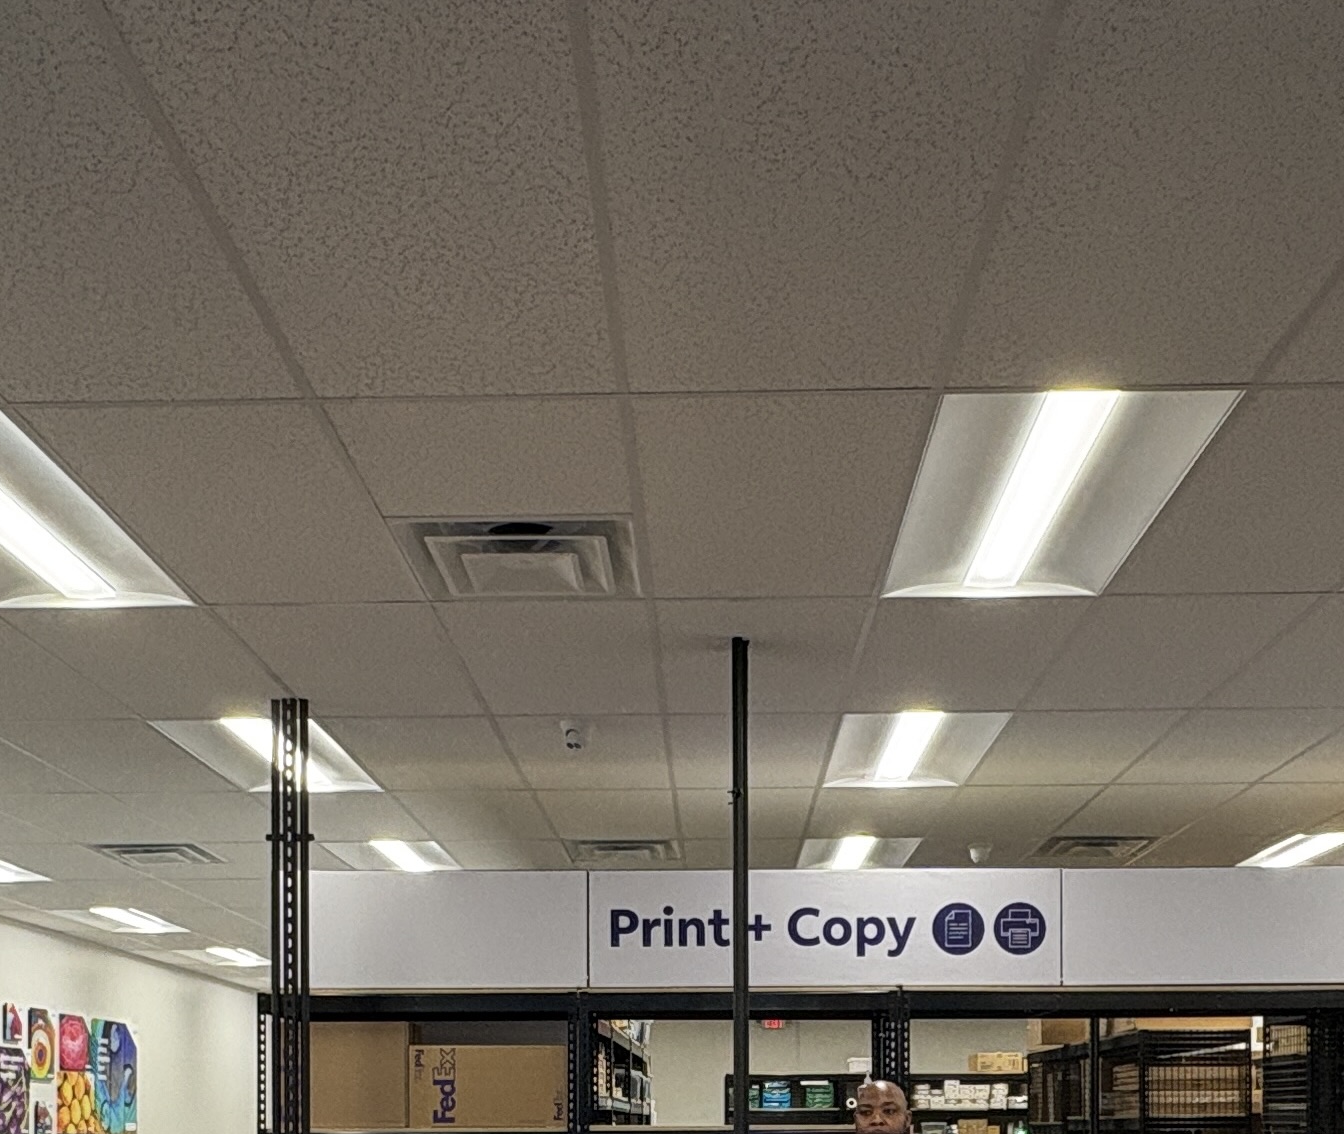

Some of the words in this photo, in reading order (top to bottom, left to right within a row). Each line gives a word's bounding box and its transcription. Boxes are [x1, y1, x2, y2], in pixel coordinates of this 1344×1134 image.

[610, 906, 731, 947] Print
[787, 907, 916, 956] Copy
[432, 1047, 456, 1124] FedEx
